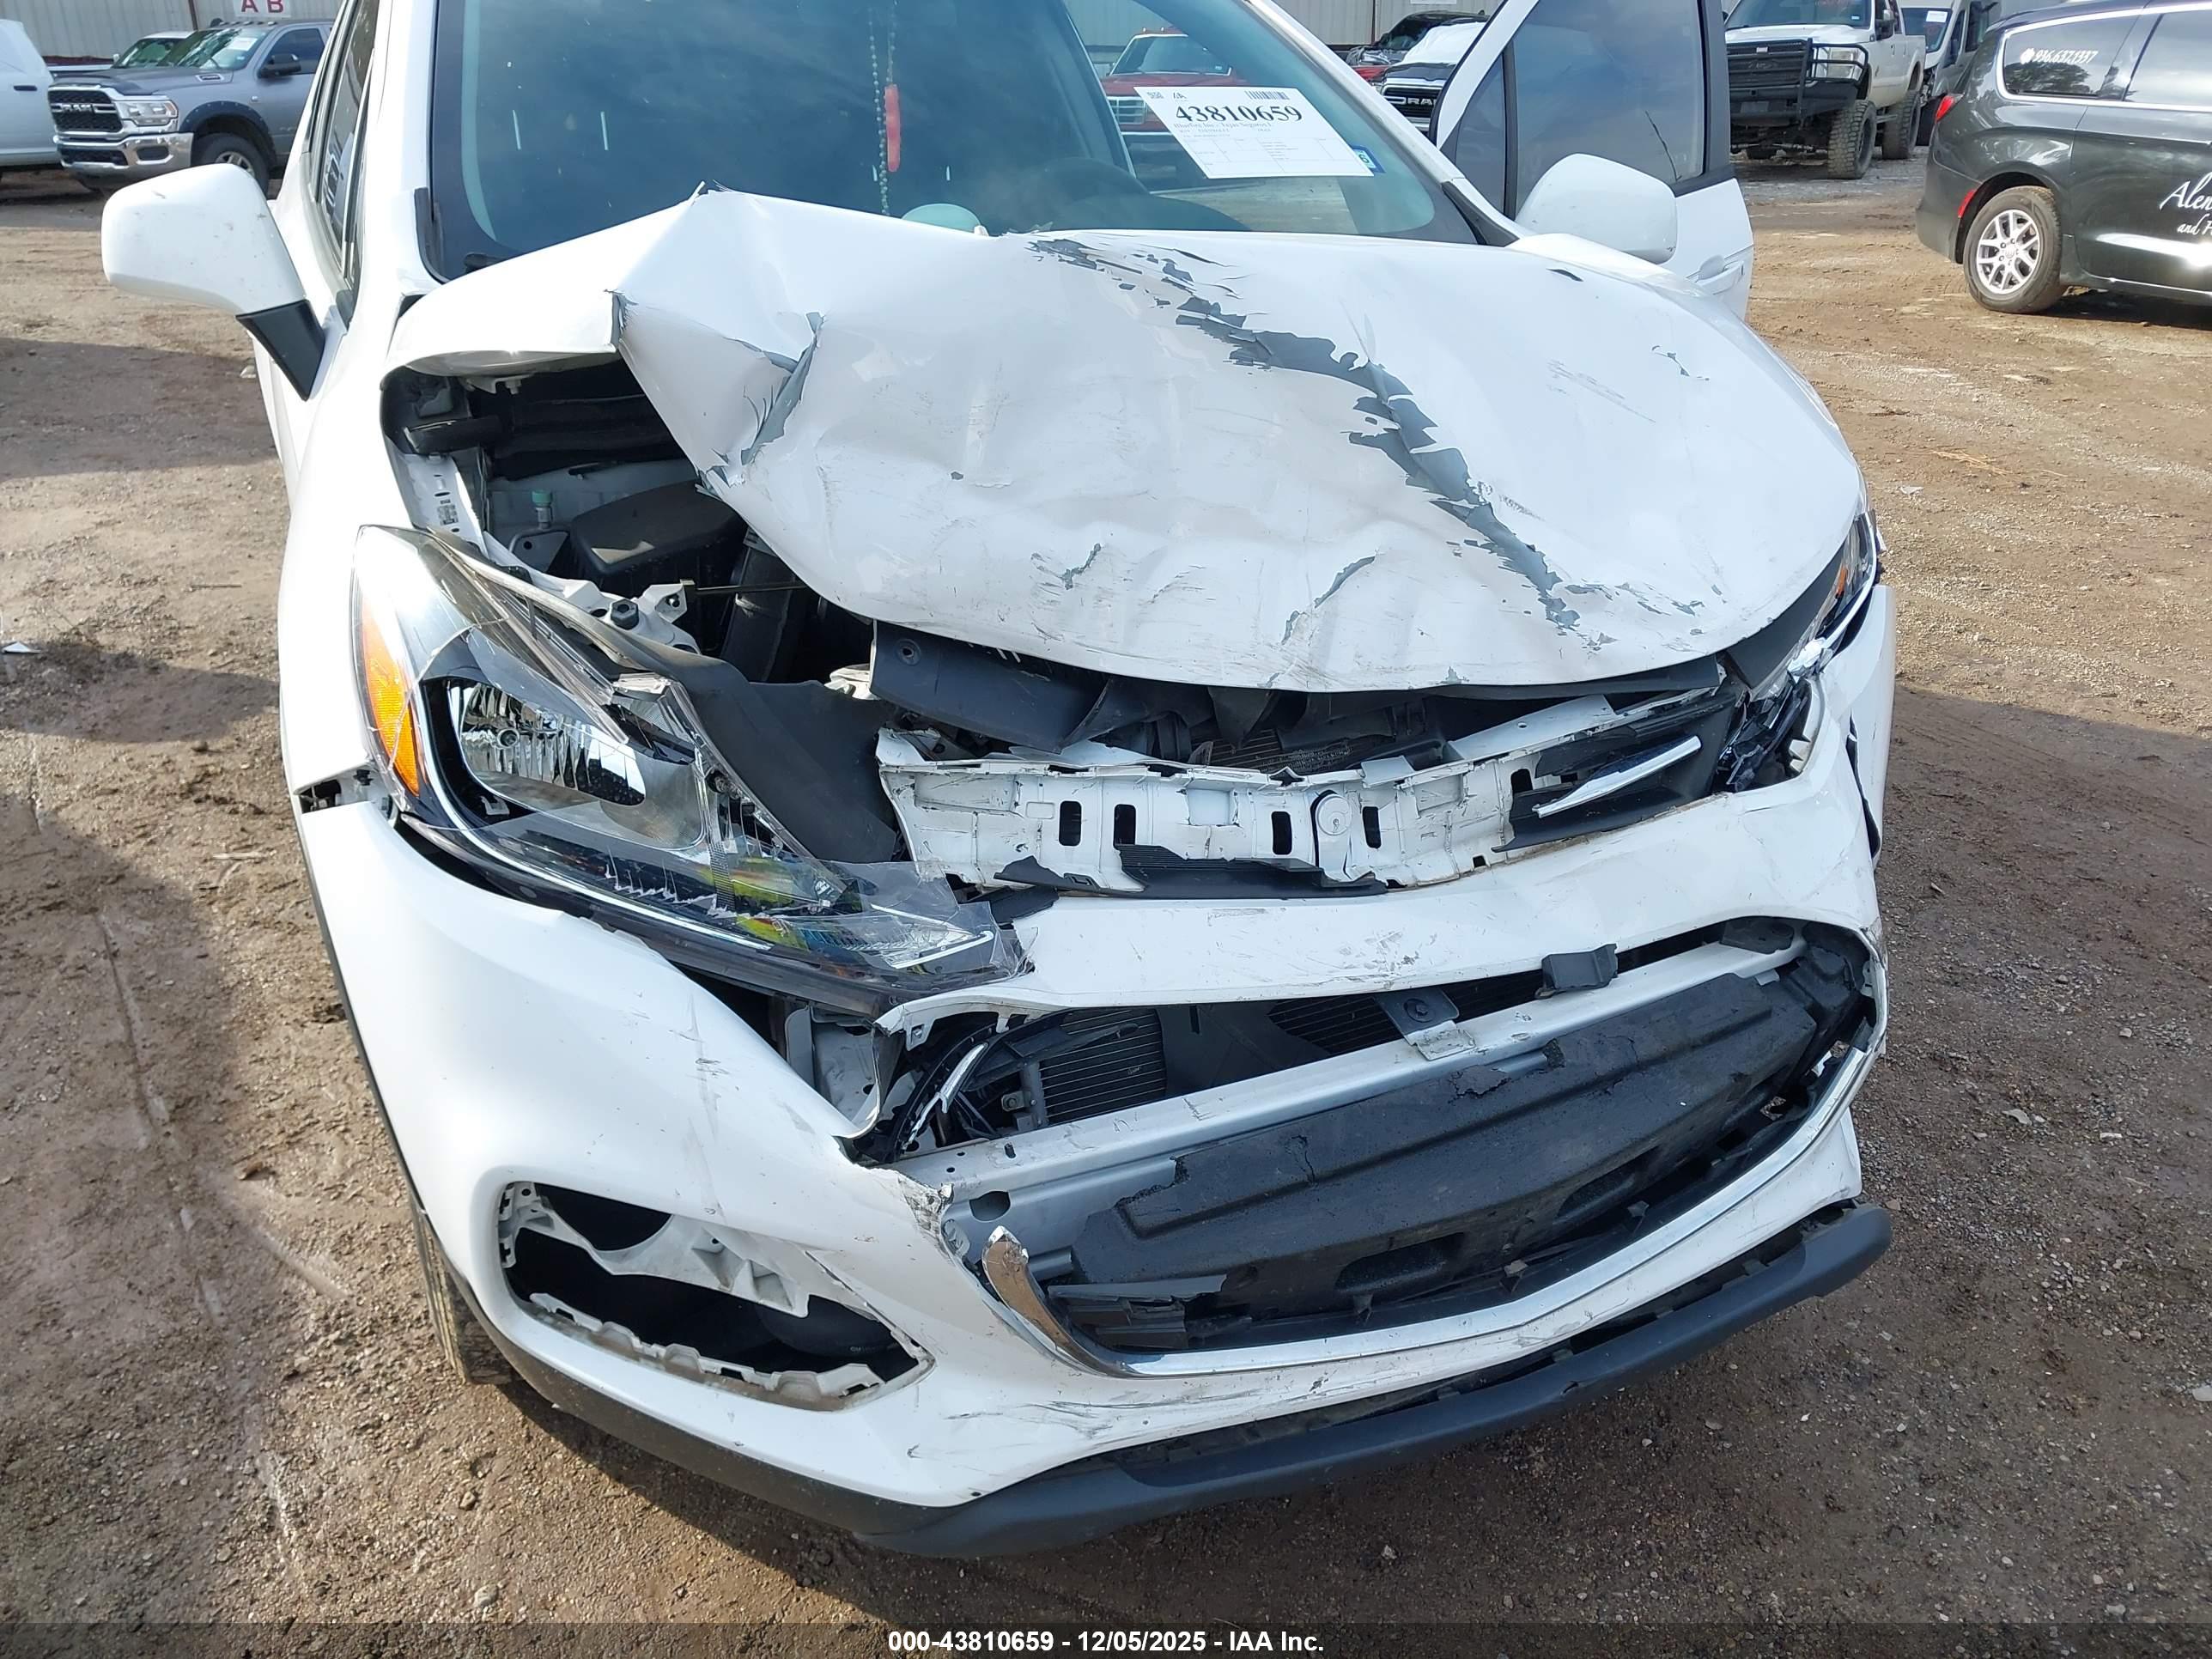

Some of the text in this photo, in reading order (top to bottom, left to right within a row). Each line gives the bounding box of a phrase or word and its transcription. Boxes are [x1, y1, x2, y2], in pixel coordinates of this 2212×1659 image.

[240, 0, 284, 14] A B
[1176, 105, 1303, 122] 43810659
[2177, 213, 2210, 235] and
